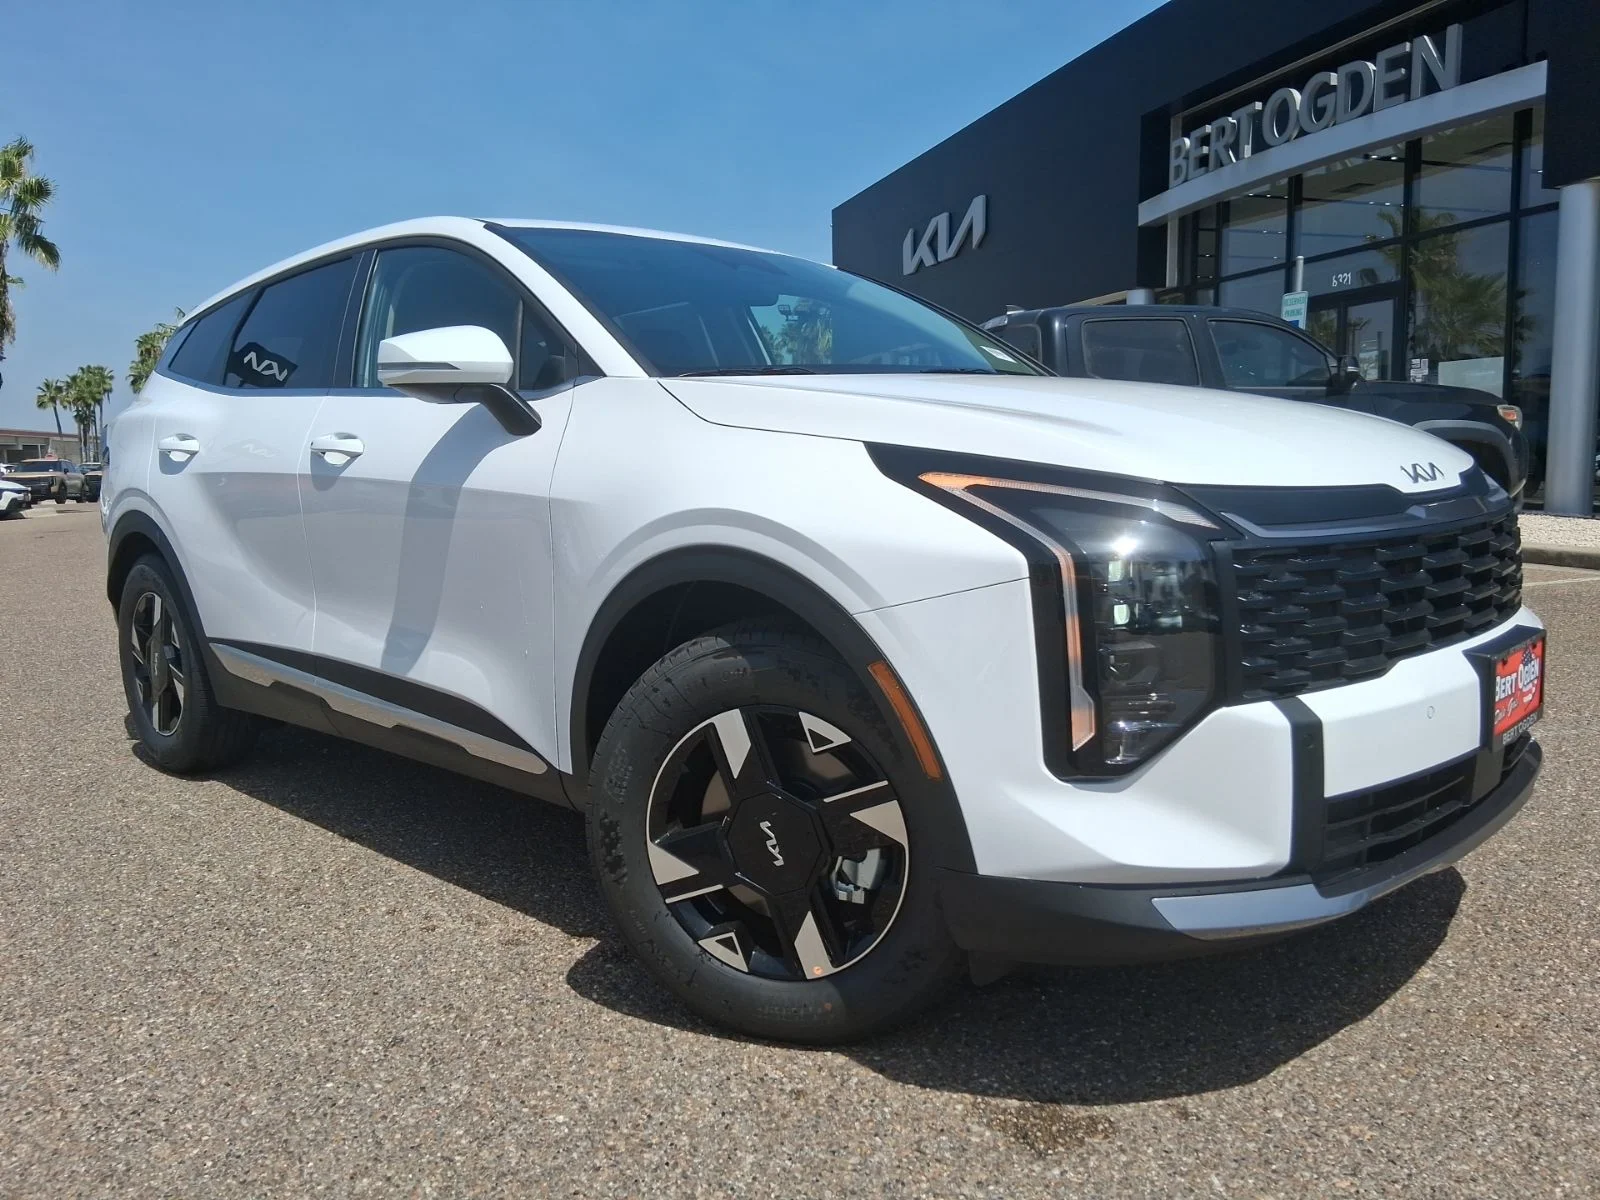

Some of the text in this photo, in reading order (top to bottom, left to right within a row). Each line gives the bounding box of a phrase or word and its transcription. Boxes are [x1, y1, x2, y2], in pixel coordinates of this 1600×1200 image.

[1168, 23, 1463, 189] BERT OGDEN
[902, 194, 987, 276] KIA
[1400, 462, 1445, 484] KIA
[1495, 672, 1517, 702] BERT
